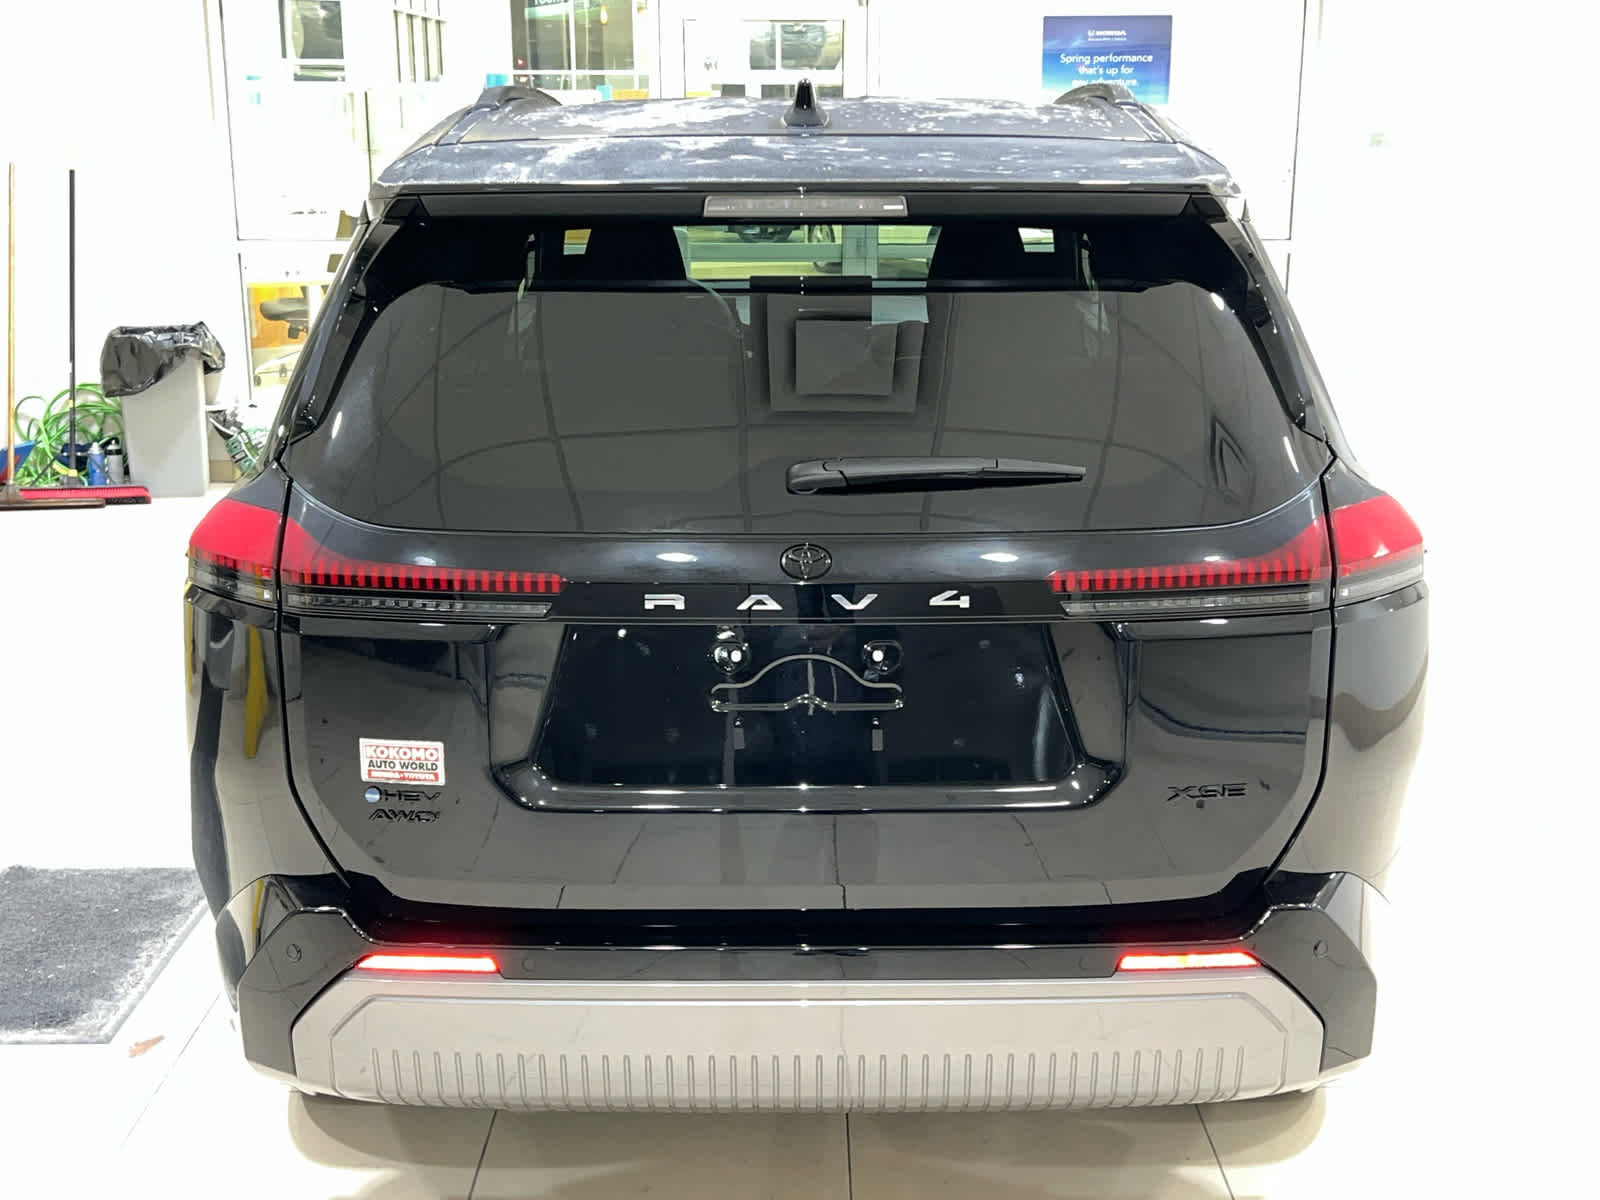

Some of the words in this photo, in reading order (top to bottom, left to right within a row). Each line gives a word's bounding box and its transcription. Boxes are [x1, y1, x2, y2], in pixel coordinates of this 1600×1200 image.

[1060, 53, 1090, 64] Spring
[1093, 53, 1153, 64] performance
[1078, 66, 1103, 75] that's
[1106, 67, 1118, 76] up
[1120, 65, 1134, 75] for
[365, 745, 439, 761] KOKOMO
[368, 760, 396, 770] AUTO
[399, 761, 438, 771] WORLD
[384, 789, 442, 801] HEV
[1167, 782, 1248, 801] XSE
[368, 808, 441, 822] AWD
